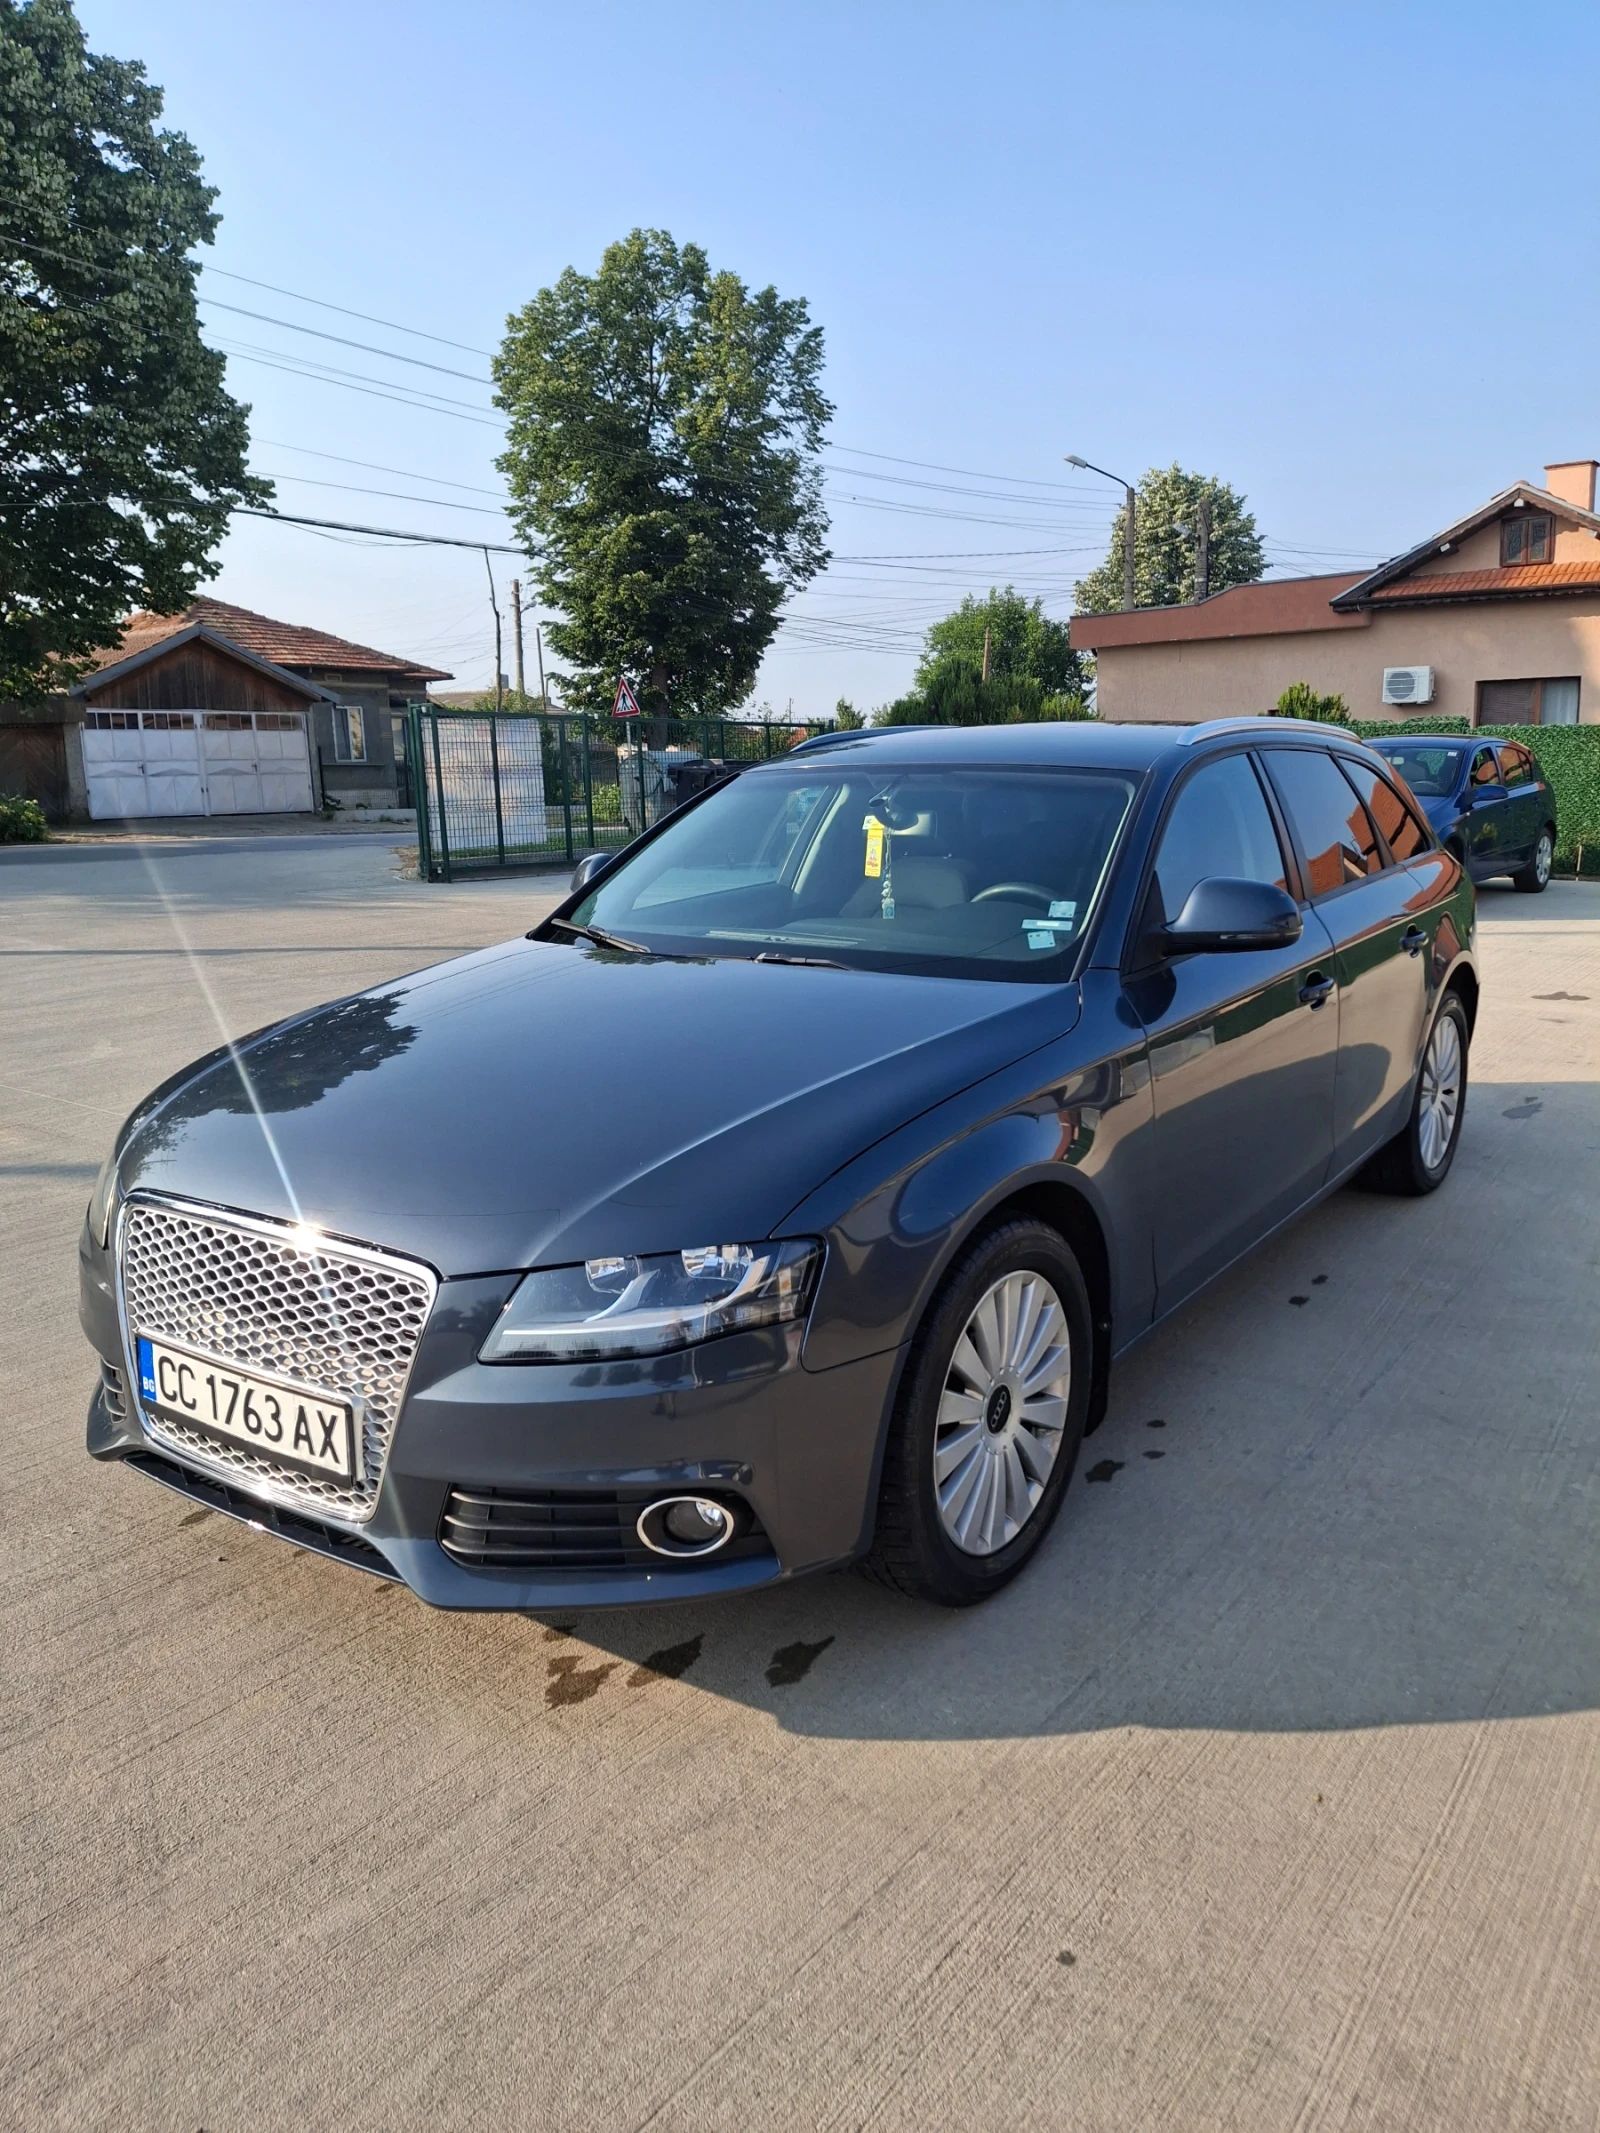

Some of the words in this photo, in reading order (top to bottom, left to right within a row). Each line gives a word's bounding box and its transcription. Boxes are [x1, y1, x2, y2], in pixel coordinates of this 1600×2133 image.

[142, 1375, 155, 1393] BG
[158, 1355, 197, 1411] CC
[206, 1374, 283, 1443] 1763
[293, 1404, 341, 1464] AX
